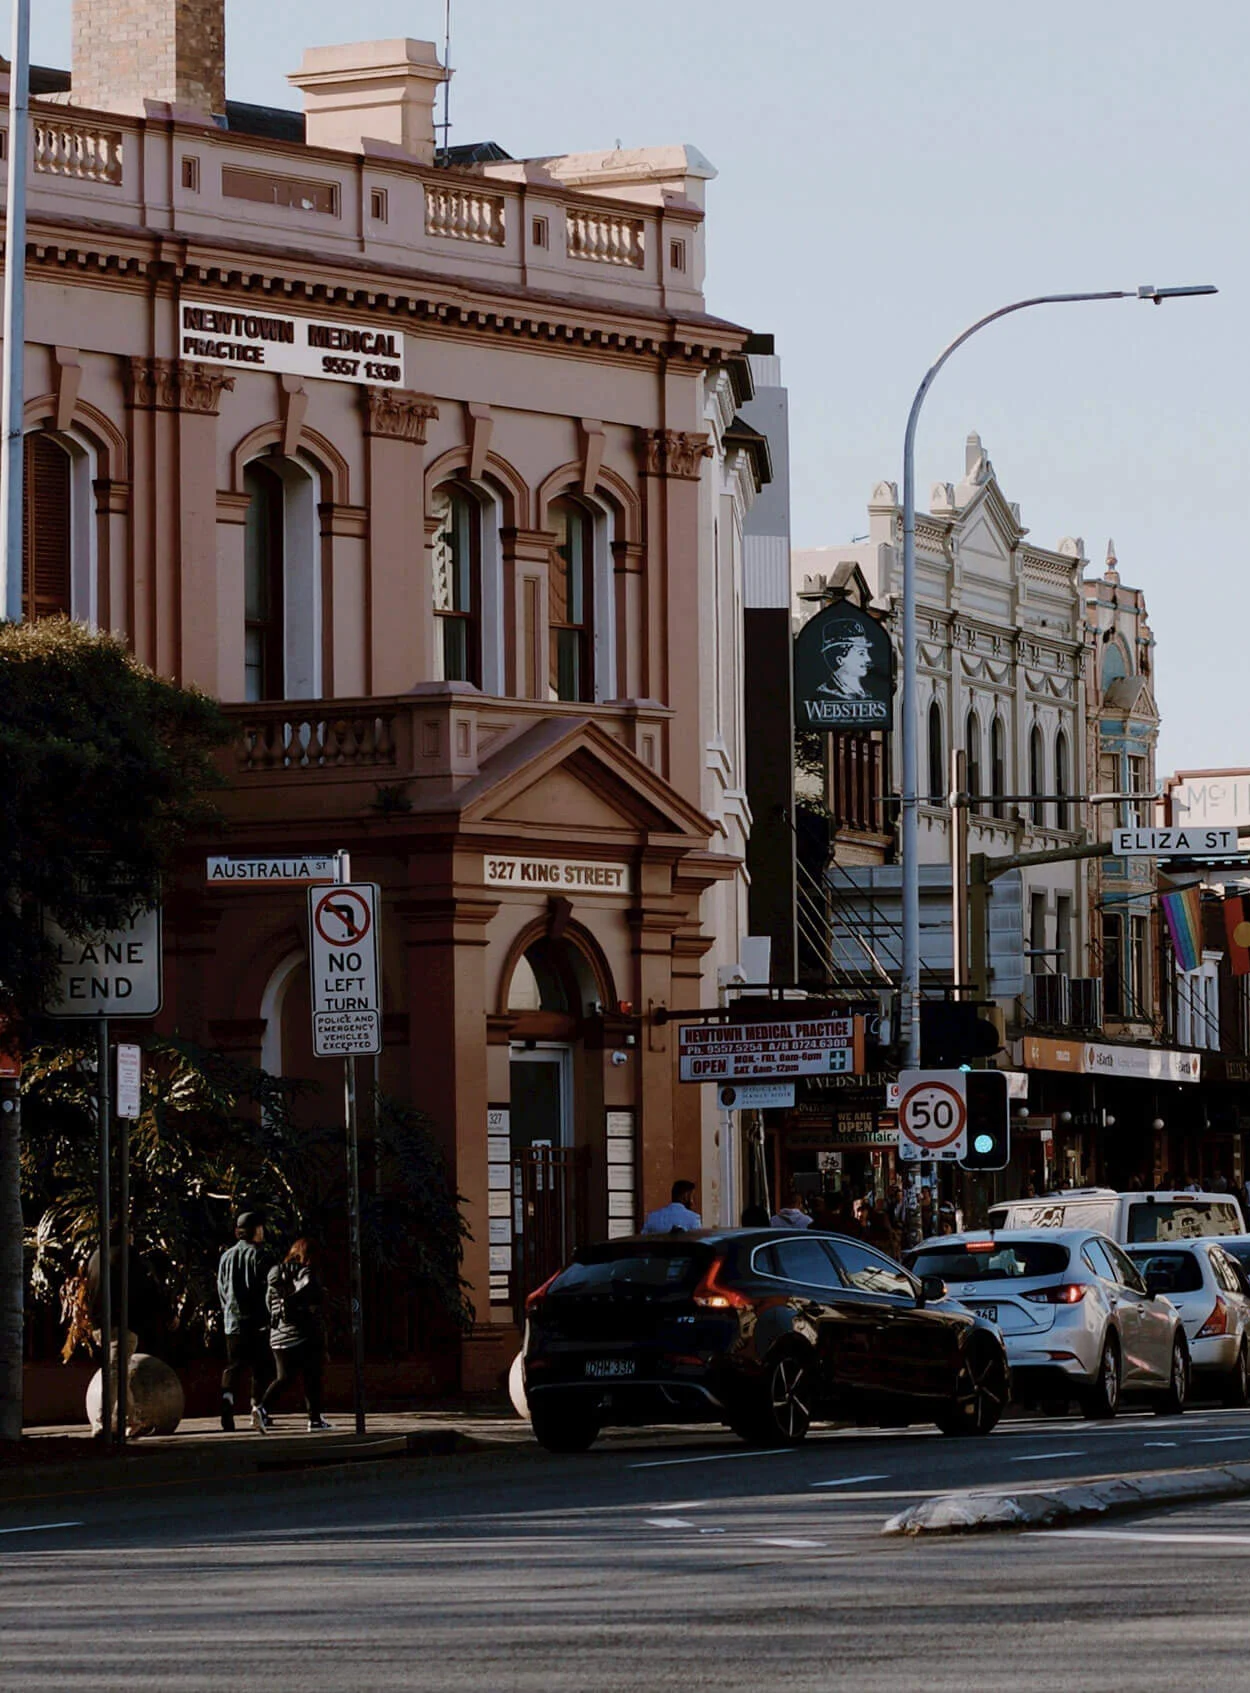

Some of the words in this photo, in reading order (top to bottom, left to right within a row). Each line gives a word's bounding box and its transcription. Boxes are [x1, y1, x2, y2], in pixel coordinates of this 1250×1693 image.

[183, 307, 294, 344] NEWTOWN
[307, 324, 401, 359] MEDICAL
[183, 336, 265, 364] PRACTICE
[322, 355, 360, 377] 9557
[1120, 832, 1191, 850] ELIZA
[1205, 831, 1231, 848] ST
[212, 863, 310, 878] AUSTRALIA
[316, 862, 326, 870] ST
[488, 861, 516, 880] 327
[520, 863, 560, 883] KING
[564, 865, 625, 887] STREET
[57, 942, 144, 964] LANE
[329, 953, 362, 972] NO
[69, 977, 133, 998] END
[324, 978, 366, 992] LEFT
[325, 997, 369, 1010] TURN
[318, 1015, 351, 1024] POLICE
[318, 1024, 374, 1033] EMERGENCY
[324, 1032, 369, 1041] VEHICLES
[685, 1028, 742, 1043] NEWTOWN
[746, 1024, 793, 1041] MEDICAL
[796, 1021, 848, 1038] PRACTICE
[323, 1041, 371, 1050] EXCEPTED
[693, 1059, 727, 1074] OPEN
[837, 1112, 851, 1121] WE
[854, 1112, 872, 1120] ARE
[912, 1100, 953, 1129] 50
[838, 1121, 873, 1133] OPEN
